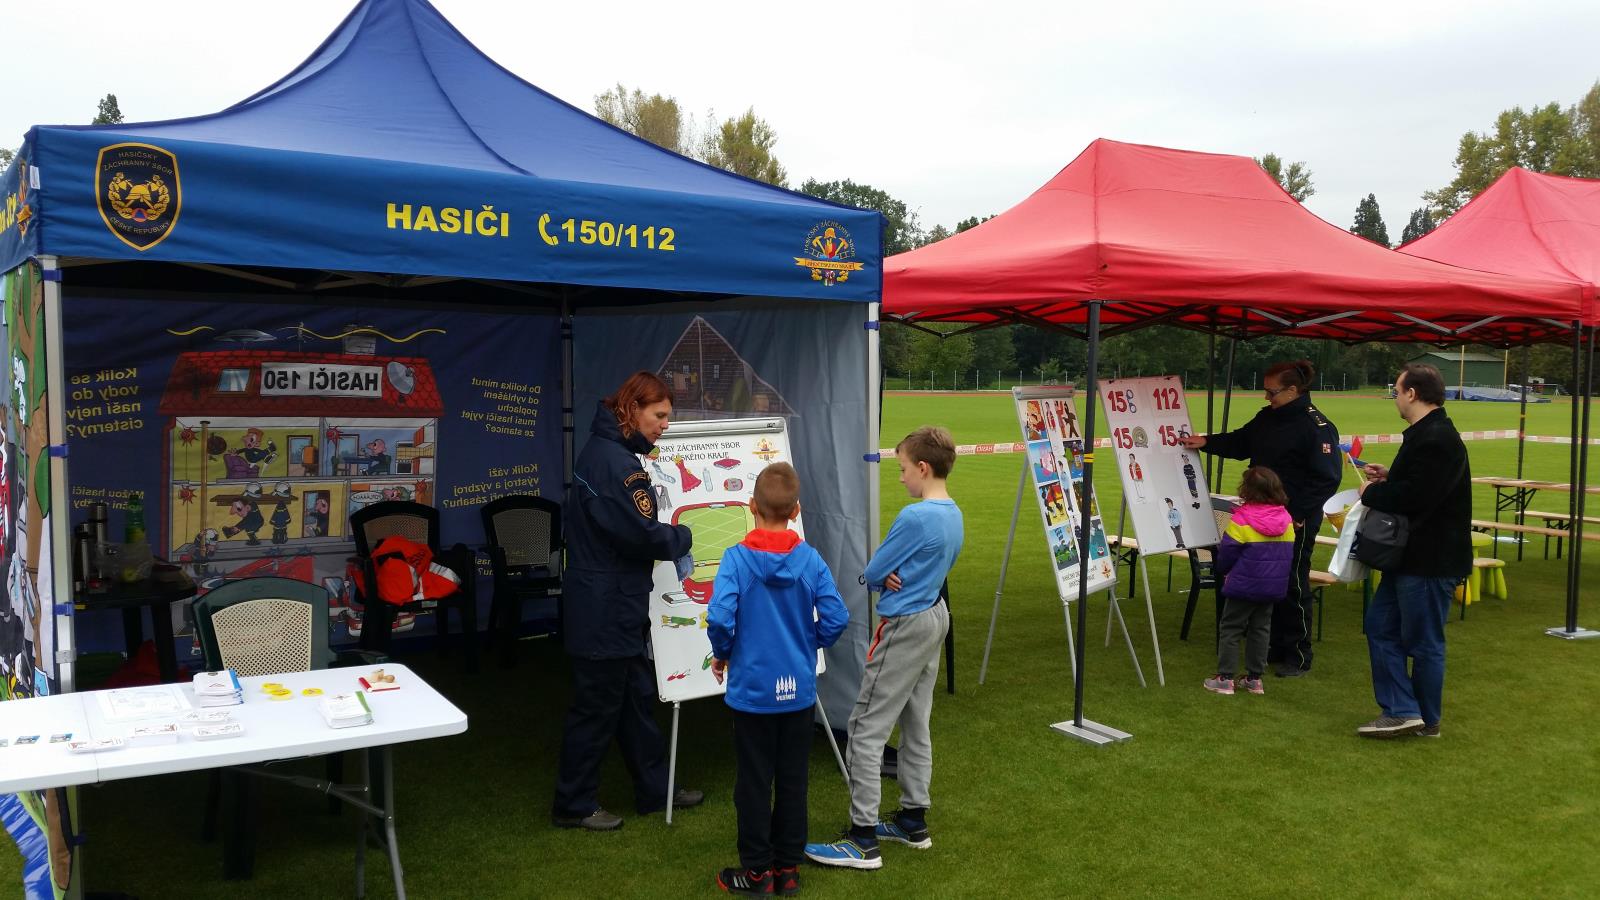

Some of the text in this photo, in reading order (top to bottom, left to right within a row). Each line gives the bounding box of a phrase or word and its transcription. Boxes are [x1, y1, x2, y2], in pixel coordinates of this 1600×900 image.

[386, 202, 675, 251] HASIČI 150/112
[1153, 387, 1181, 410] 112
